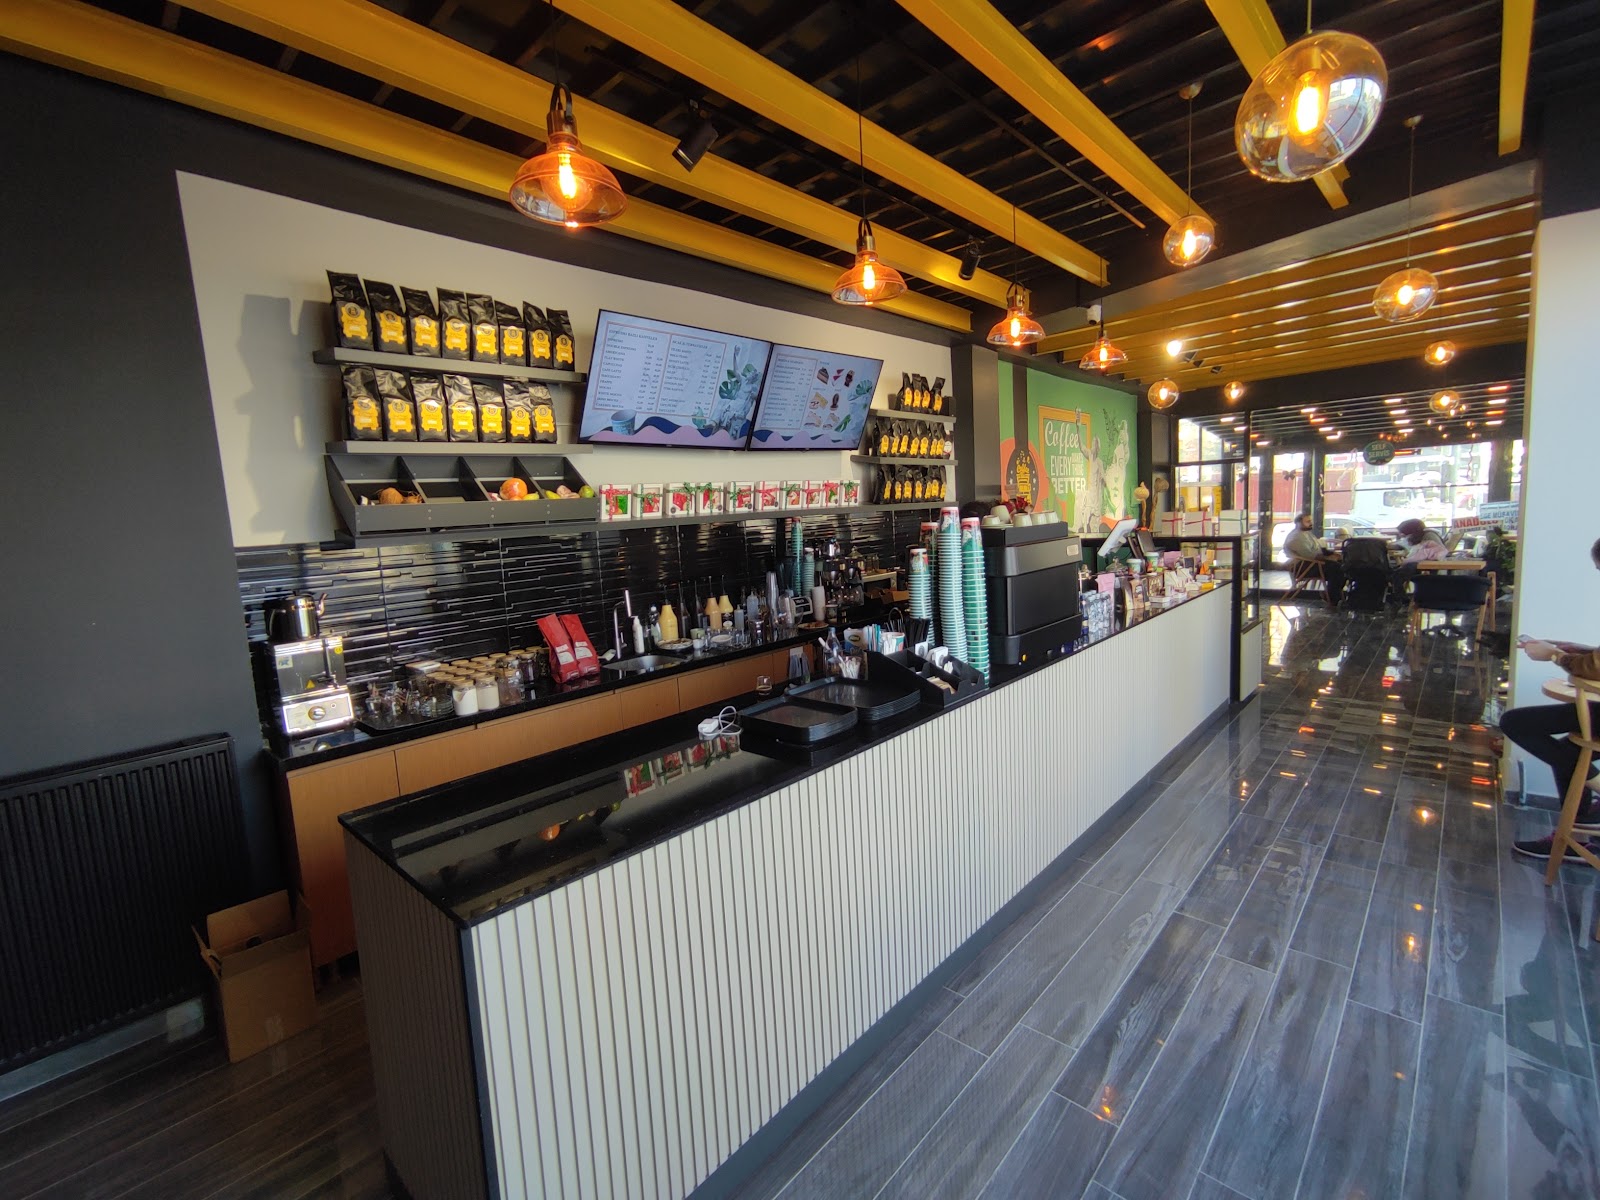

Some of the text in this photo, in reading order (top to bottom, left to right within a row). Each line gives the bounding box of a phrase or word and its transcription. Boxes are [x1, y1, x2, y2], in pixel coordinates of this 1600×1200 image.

[1045, 421, 1080, 455] Coffee
[1371, 443, 1386, 451] SELF
[1050, 455, 1072, 476] EVERY
[1051, 477, 1086, 494] BETTER
